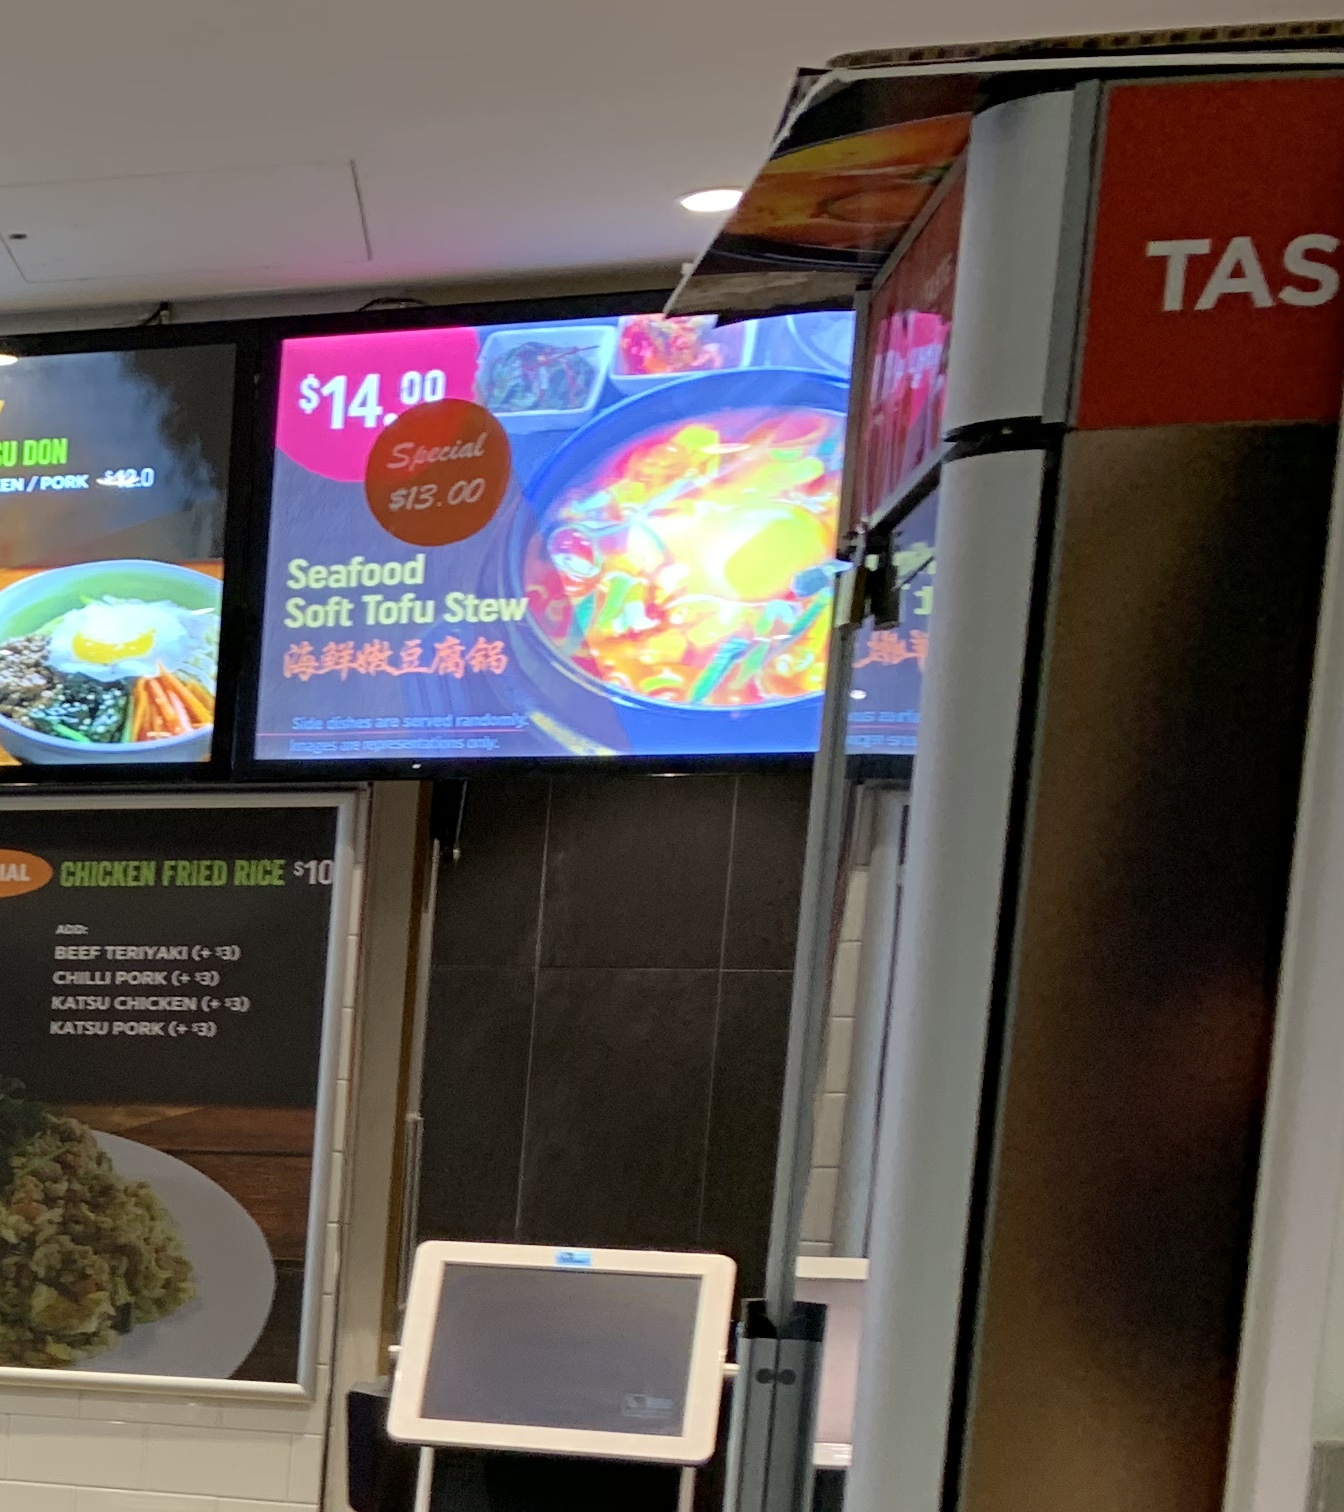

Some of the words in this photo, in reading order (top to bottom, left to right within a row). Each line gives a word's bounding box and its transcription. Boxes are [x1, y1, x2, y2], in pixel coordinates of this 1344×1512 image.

[1146, 233, 1340, 313] TAS
[22, 437, 68, 465] DON
[386, 432, 488, 471] Special
[40, 474, 89, 490] PORK
[389, 478, 486, 512] $13.00
[286, 553, 426, 590] Seafood
[283, 596, 355, 628] Soft
[362, 593, 435, 625] Tofu
[443, 591, 530, 624] Stew
[60, 861, 155, 887] CHICKEN
[162, 860, 227, 887] FRIED
[234, 860, 285, 886] RICE
[293, 860, 333, 885] $10
[54, 945, 101, 960] BEEF
[104, 945, 189, 960] TERIYAKI
[53, 971, 111, 986] CHILLI
[115, 971, 167, 986] PORK
[51, 996, 110, 1011] KATSU
[114, 996, 198, 1011] CHICKEN
[49, 1021, 109, 1036] KATSU
[112, 1021, 165, 1036] PORK
